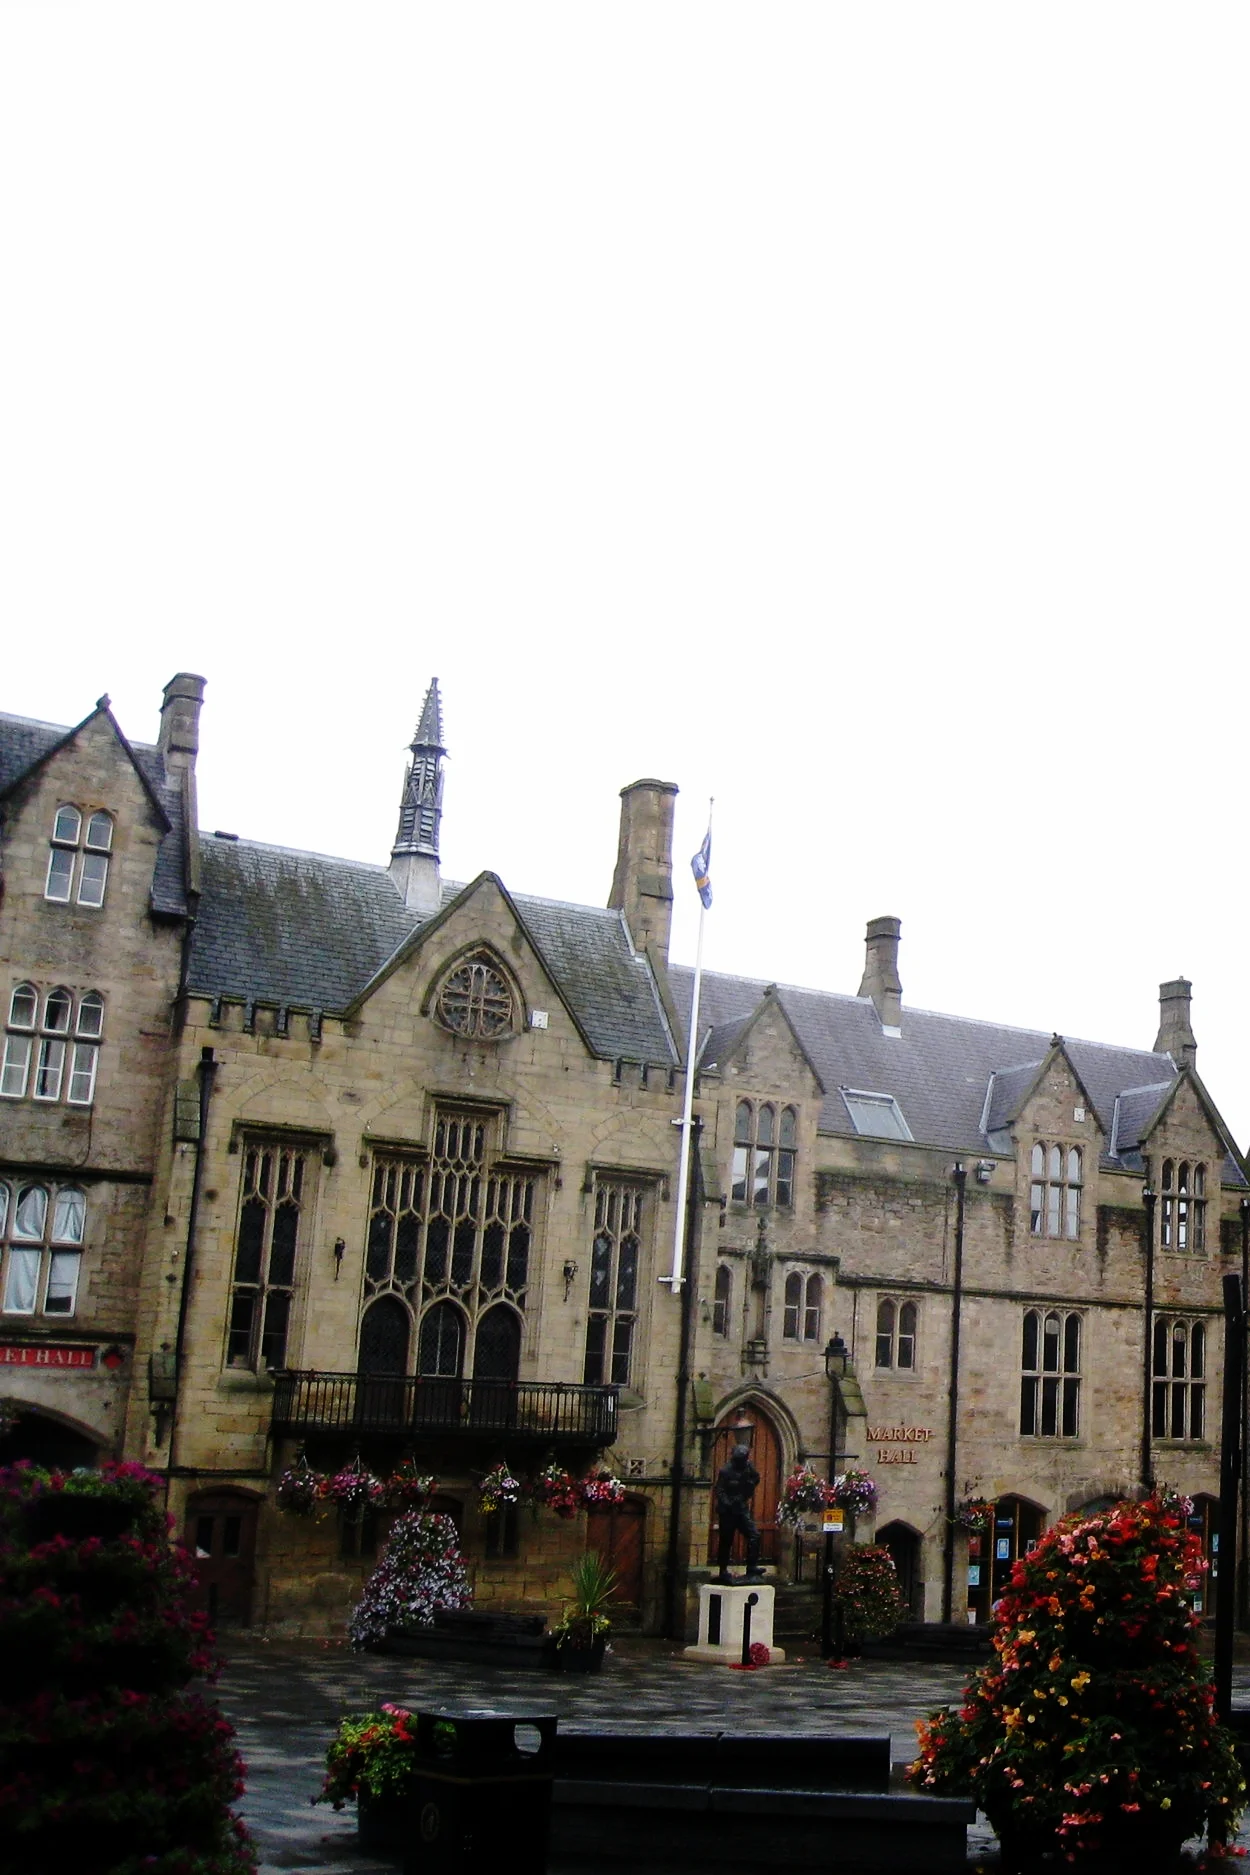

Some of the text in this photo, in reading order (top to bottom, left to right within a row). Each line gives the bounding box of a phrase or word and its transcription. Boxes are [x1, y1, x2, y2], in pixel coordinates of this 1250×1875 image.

[0, 1347, 92, 1365] ET HALL
[866, 1426, 932, 1442] MARKET
[878, 1448, 918, 1464] HALL
